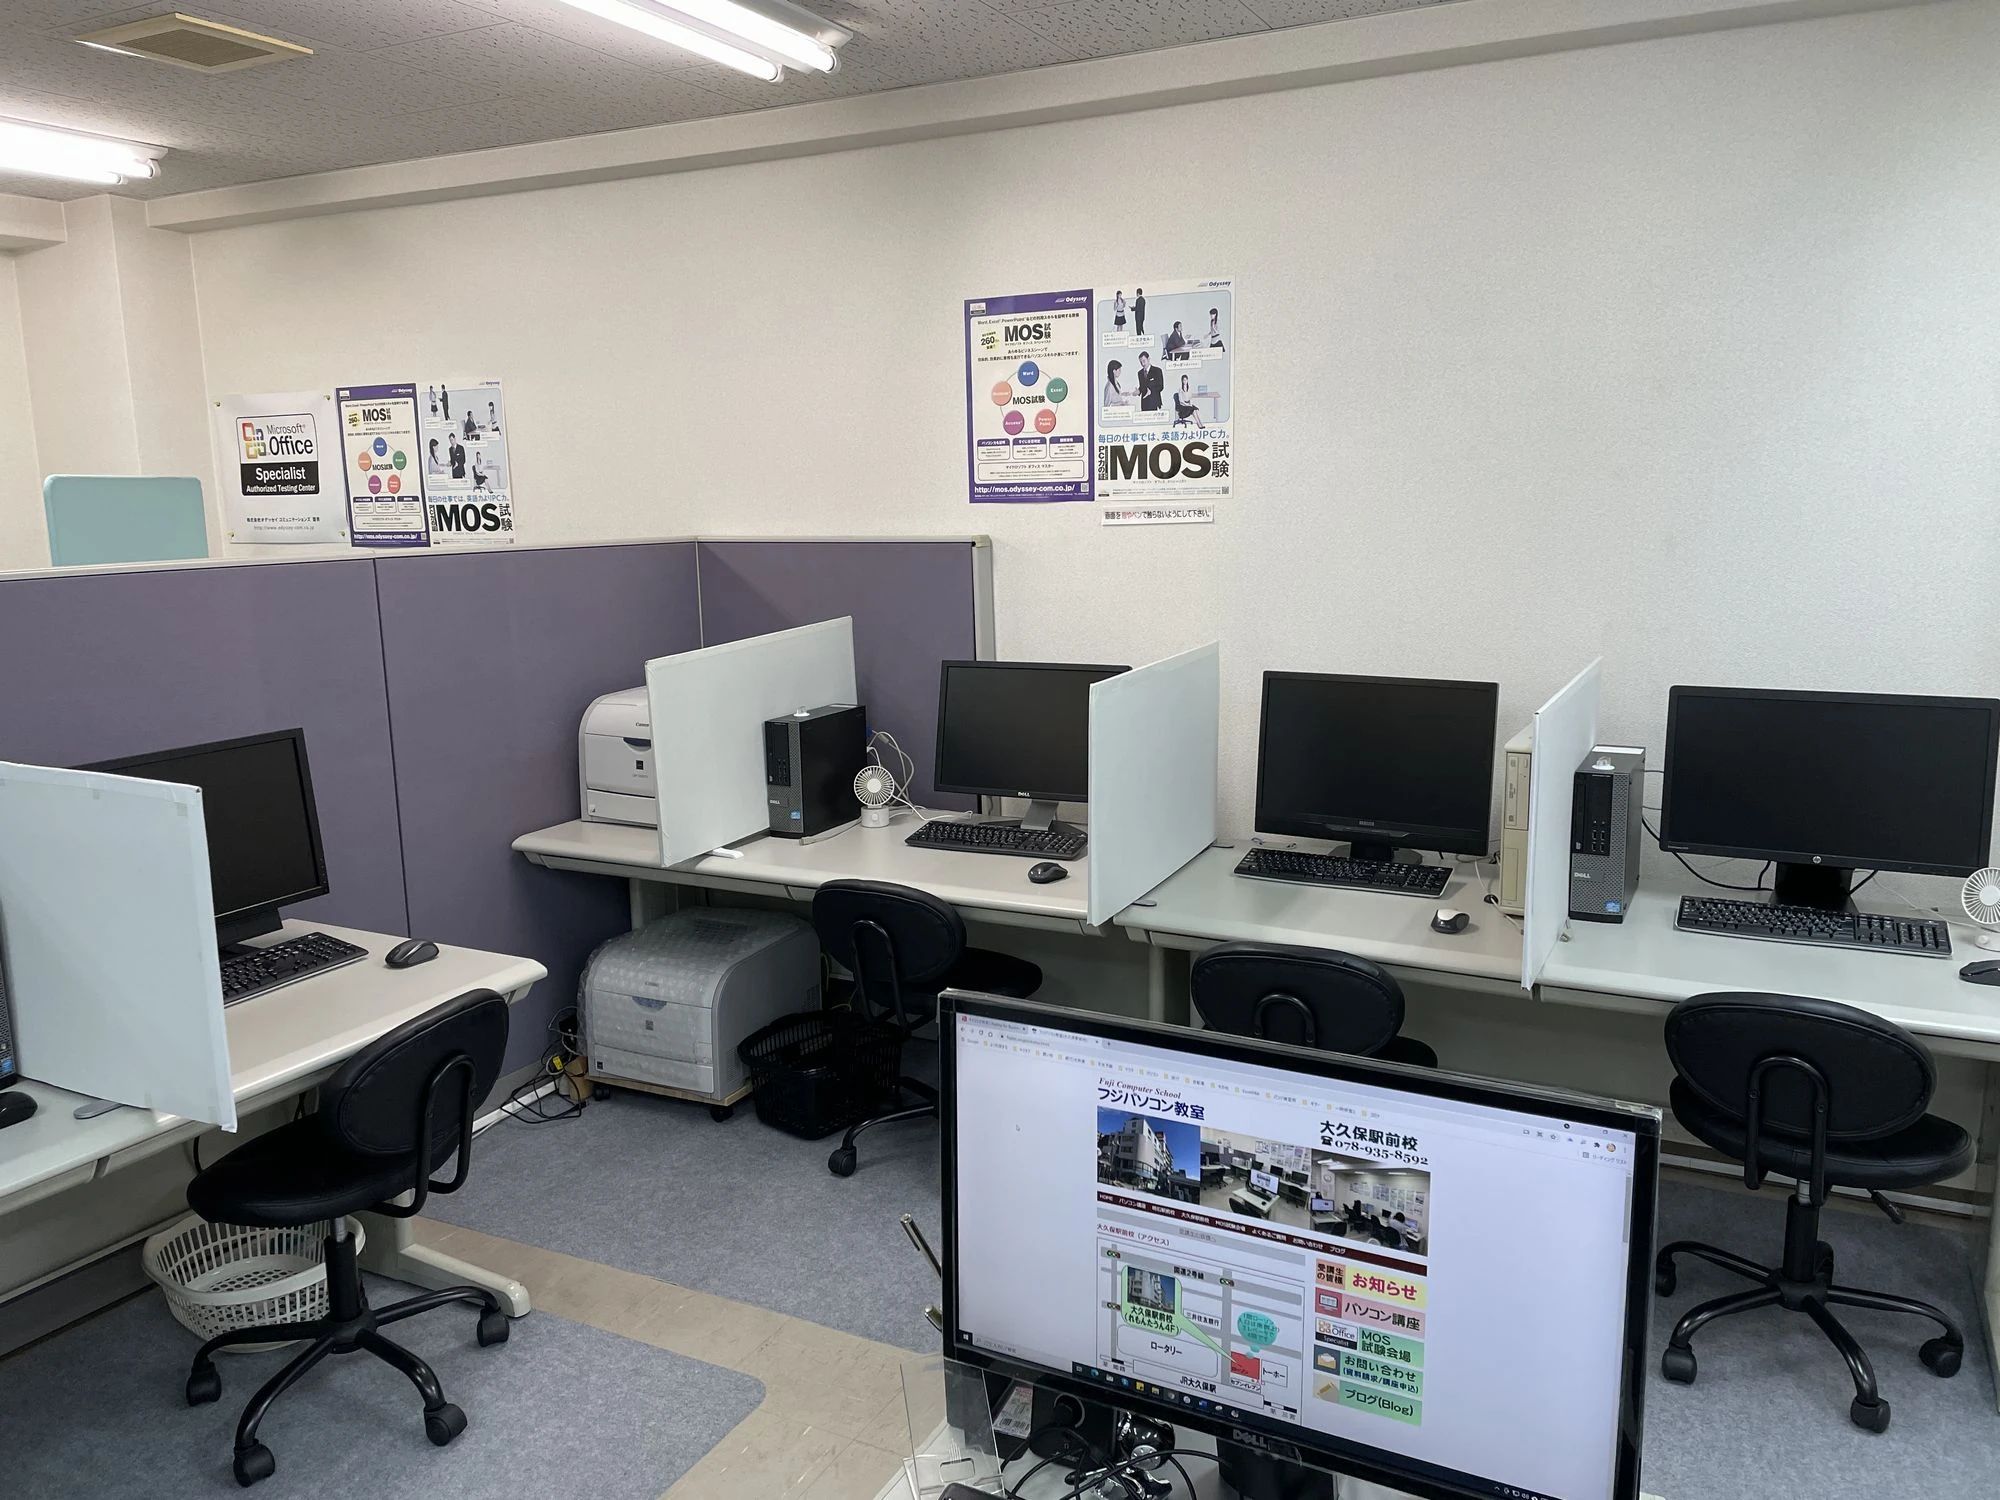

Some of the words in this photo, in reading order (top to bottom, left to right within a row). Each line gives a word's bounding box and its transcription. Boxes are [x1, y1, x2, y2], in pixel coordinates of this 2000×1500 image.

[1004, 323, 1043, 342] MOS
[1044, 323, 1051, 338] 試験
[1012, 395, 1045, 405] MOS試験
[362, 408, 386, 422] MOS
[267, 423, 304, 434] Microsoft
[1098, 430, 1229, 444] 毎日の仕事では、英語力よりPC力。
[269, 435, 313, 455] Office
[1110, 442, 1211, 480] MOS
[1212, 441, 1229, 477] 試験
[256, 467, 306, 483] Specialist
[278, 484, 298, 493] Testing
[975, 484, 1075, 493] http://mos.odyssey-com.co.jp/
[436, 503, 500, 531] MOS
[499, 503, 513, 531] 試験
[1099, 1077, 1115, 1088] Fuji
[1116, 1080, 1152, 1096] Computer
[1155, 1088, 1181, 1099] School
[1097, 1088, 1205, 1120] フジパソコン教室
[1320, 1120, 1418, 1151] 大久保駅前校
[1335, 1140, 1428, 1165] 078-935-8592
[1353, 1273, 1417, 1300] お知らせ
[1130, 1306, 1173, 1324] 大久保駅前校
[1345, 1302, 1420, 1331] パソコン講座
[1332, 1328, 1355, 1340] Office
[1361, 1330, 1391, 1345] MOS
[1150, 1342, 1183, 1355] ロータリー
[1362, 1340, 1411, 1363] 試験会場
[1262, 1367, 1285, 1378] トーホー
[1345, 1356, 1416, 1382] お問い合わせ
[1180, 1375, 1216, 1394] JR大久保駅
[1231, 1379, 1260, 1391] セブンイレブン
[1345, 1389, 1413, 1416] ブログ(Blog)
[1233, 1429, 1267, 1448] DELL
